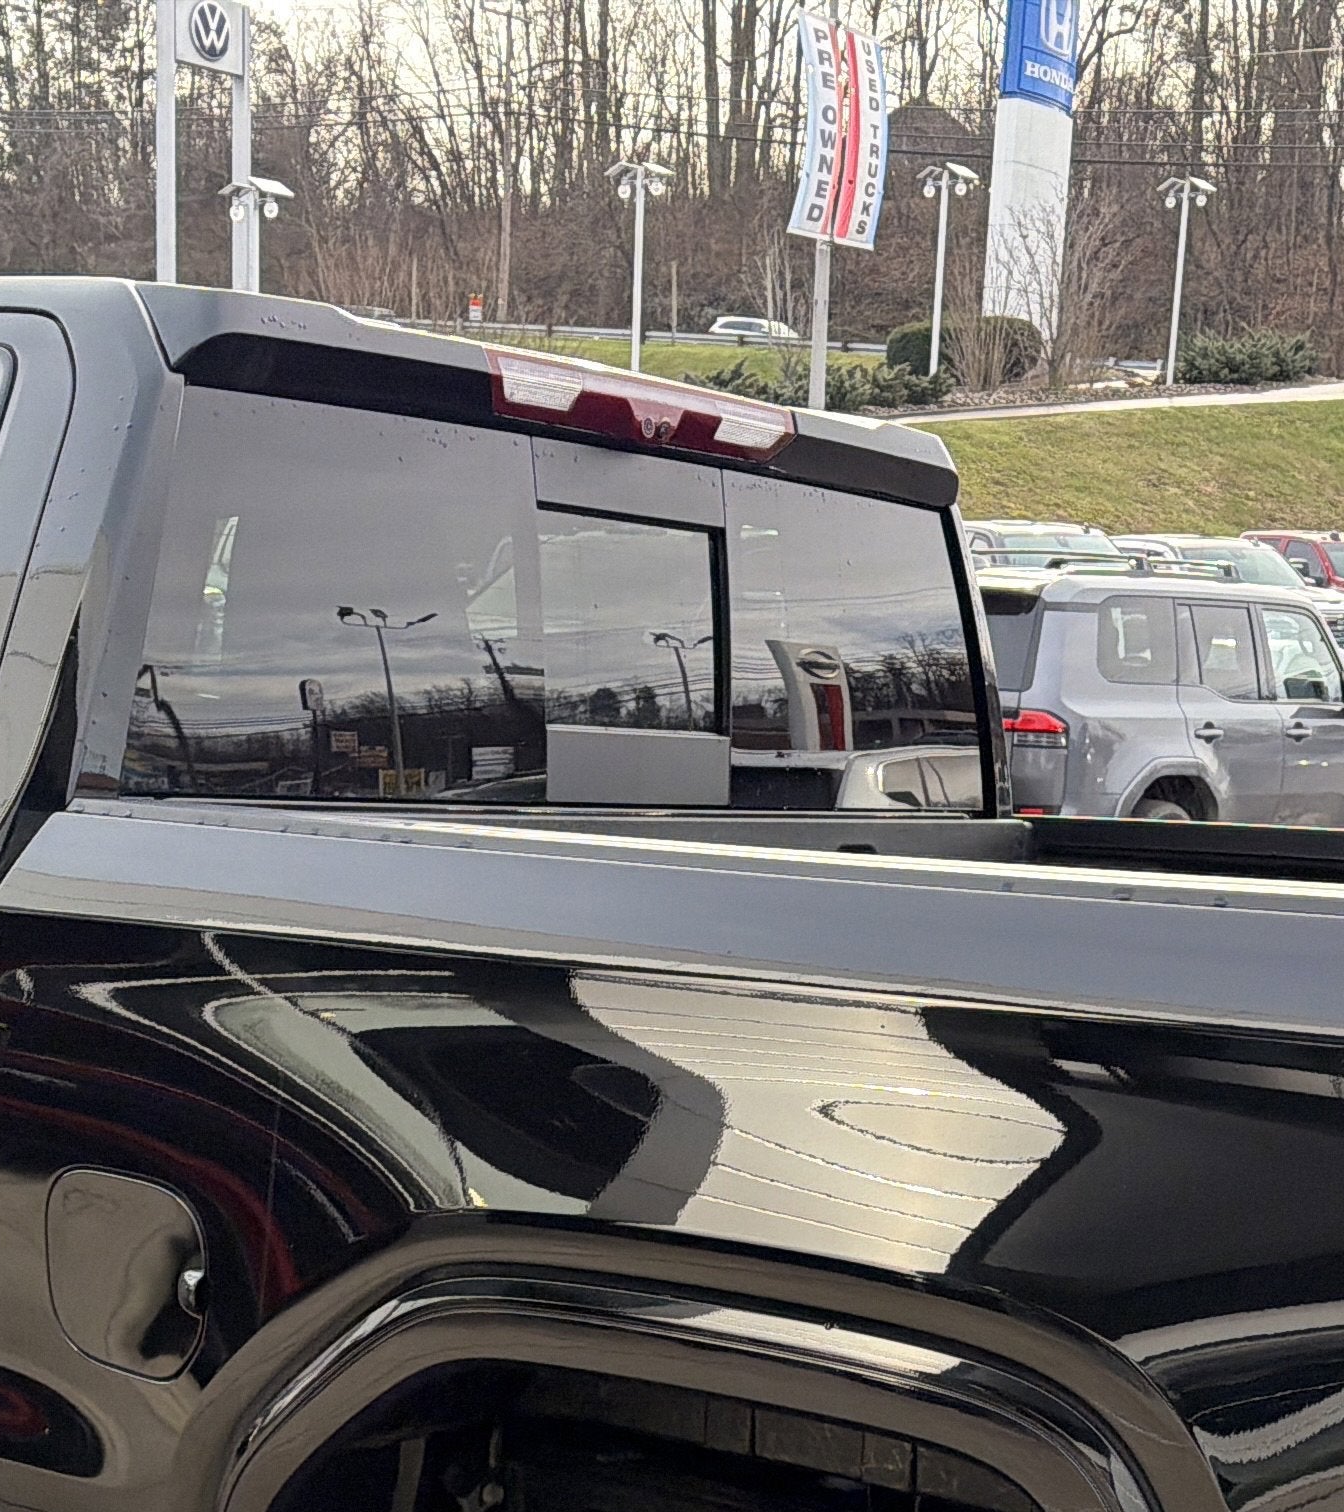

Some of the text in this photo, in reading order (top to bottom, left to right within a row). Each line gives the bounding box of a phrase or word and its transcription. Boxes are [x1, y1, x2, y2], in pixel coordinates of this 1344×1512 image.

[806, 27, 837, 223] PRE OWNED
[855, 40, 880, 235] USED TRUCKS
[1024, 60, 1074, 94] HONDA
